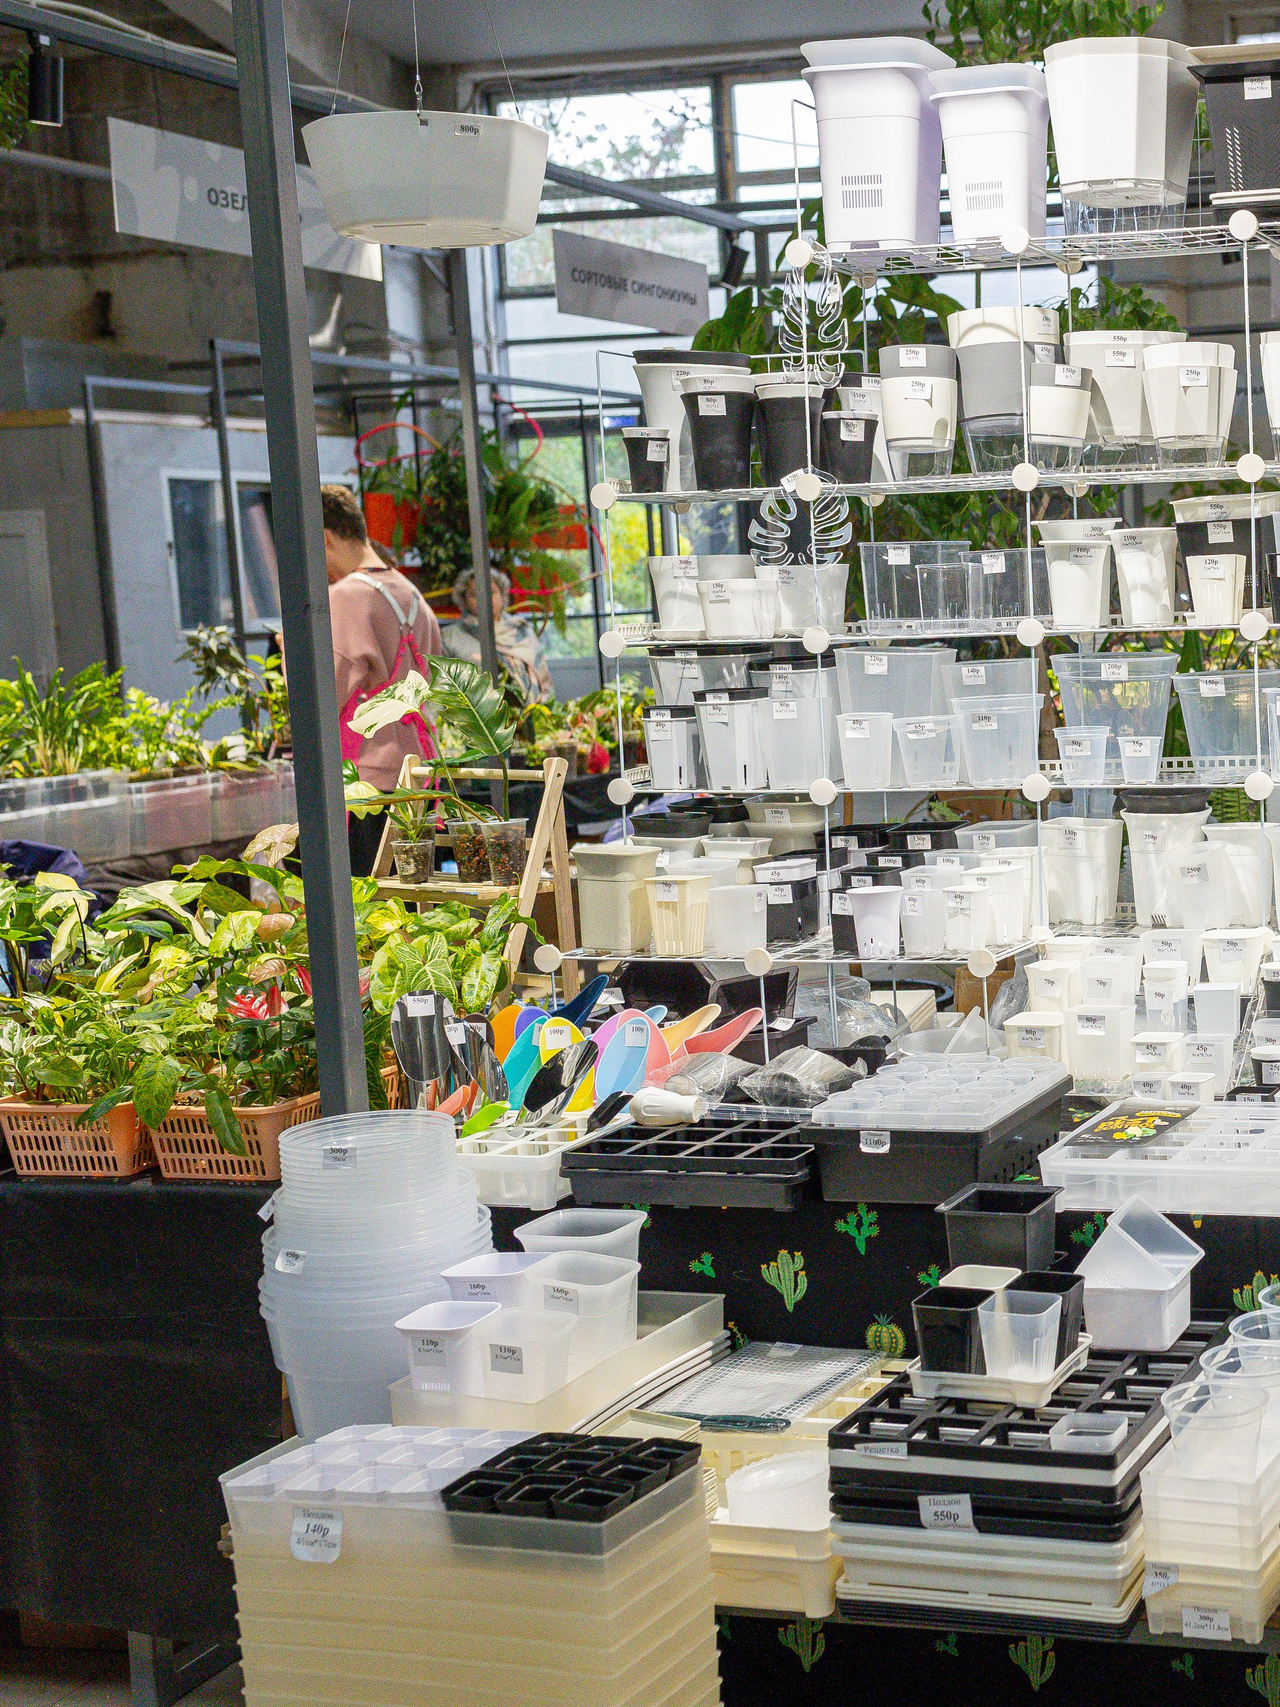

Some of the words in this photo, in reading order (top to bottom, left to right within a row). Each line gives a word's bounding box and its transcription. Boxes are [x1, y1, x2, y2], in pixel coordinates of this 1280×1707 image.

[460, 124, 479, 136] 800р
[412, 997, 428, 1005] 550р
[549, 1028, 564, 1036] 100р
[329, 1147, 348, 1156] 300р
[468, 1282, 486, 1292] 160р
[552, 1286, 569, 1297] 160р
[421, 1338, 439, 1348] 110р
[498, 1345, 516, 1355] 110р
[933, 1510, 959, 1521] 550р
[305, 1523, 330, 1538] 140р
